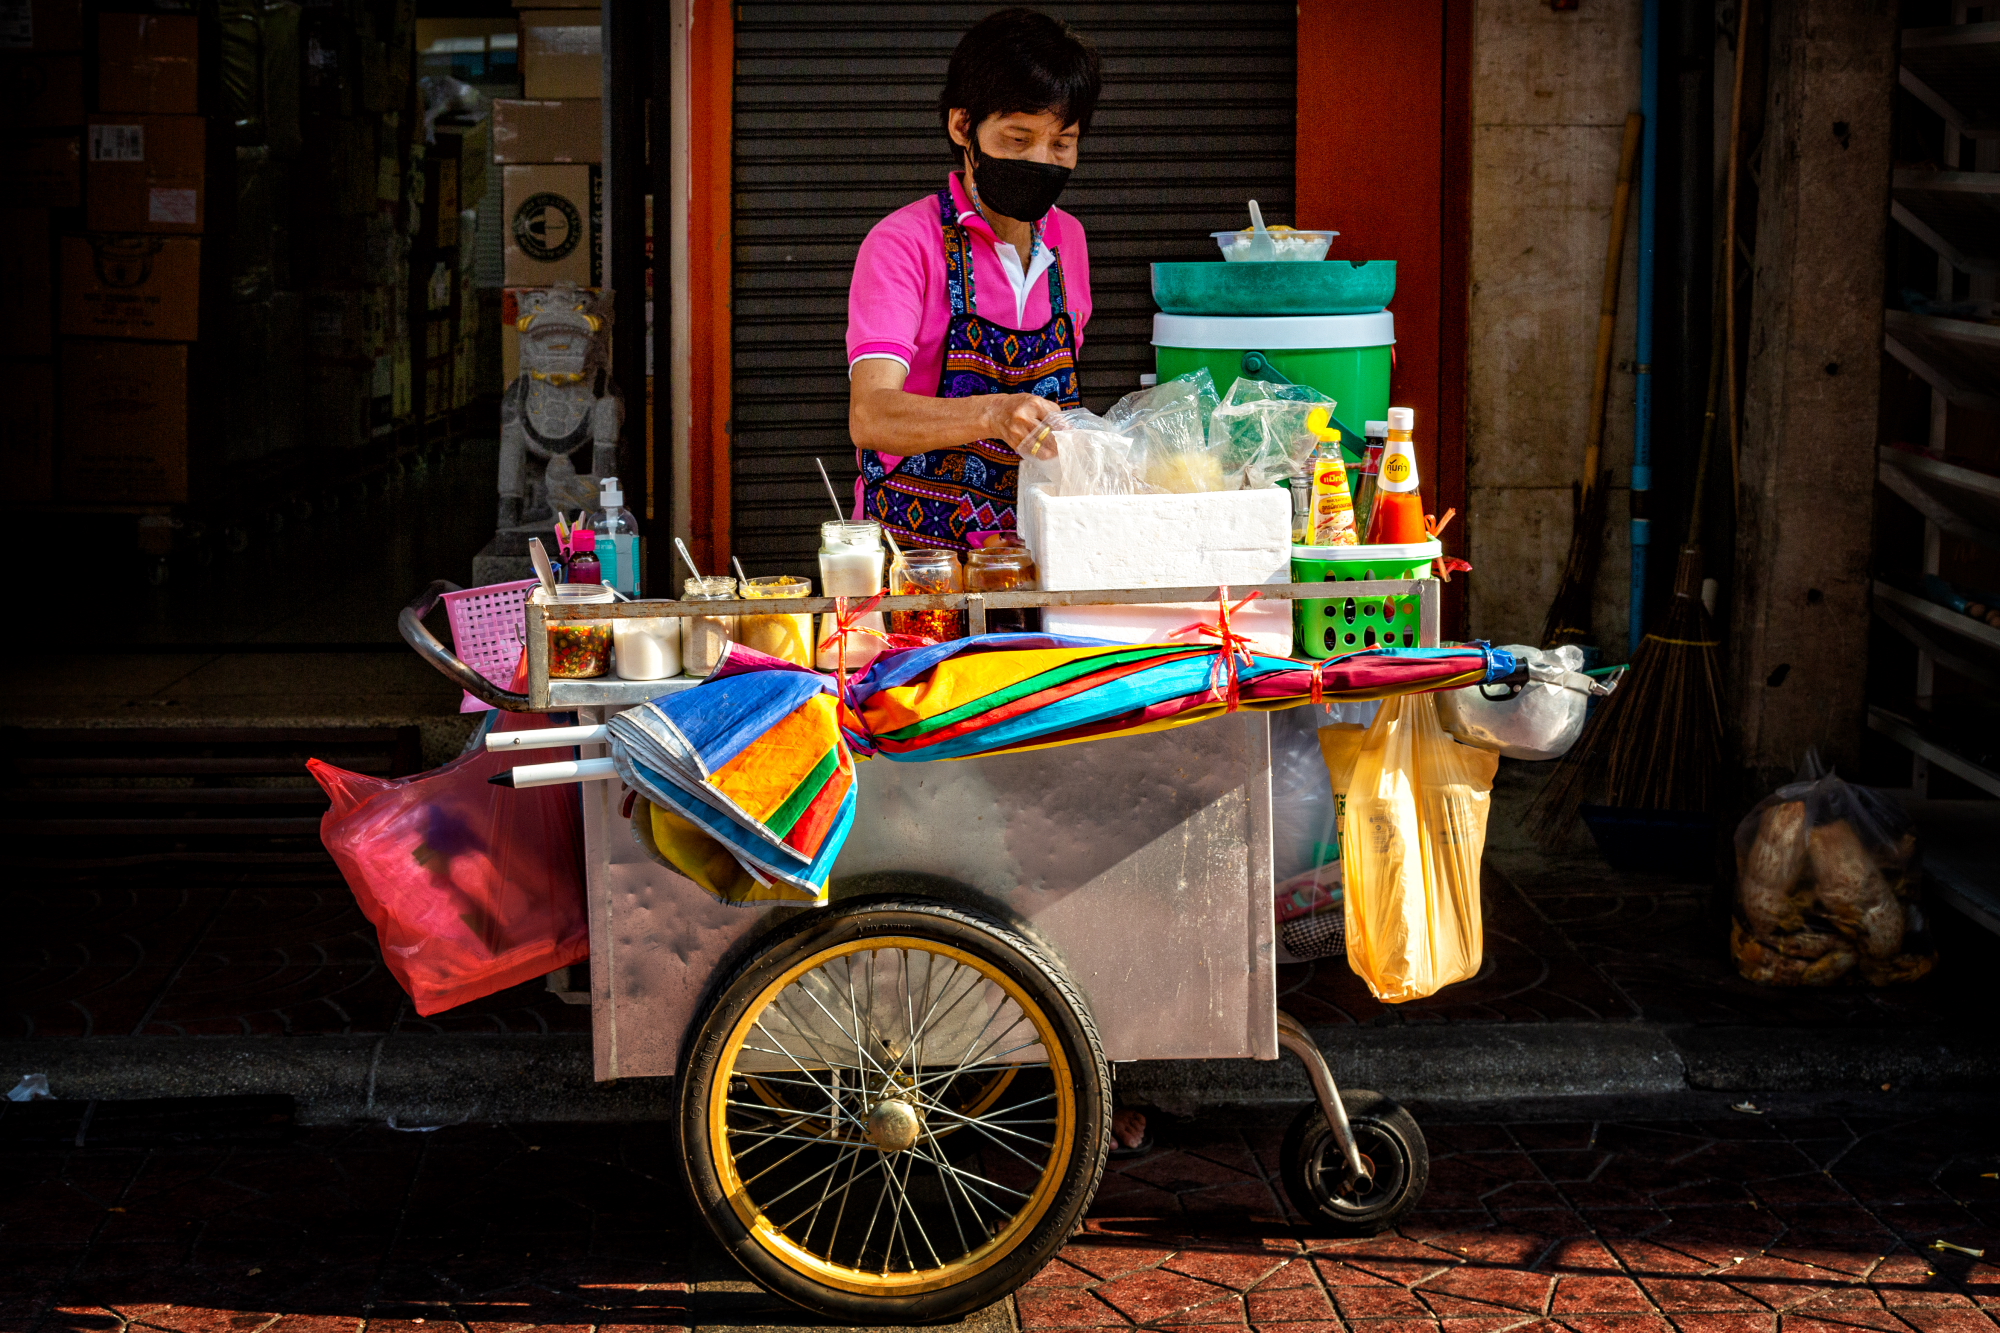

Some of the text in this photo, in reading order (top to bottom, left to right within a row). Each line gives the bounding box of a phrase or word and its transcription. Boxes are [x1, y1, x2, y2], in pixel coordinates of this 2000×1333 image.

[1386, 459, 1408, 474] คุ้มค่า
[692, 1031, 723, 1097] CAMEL
